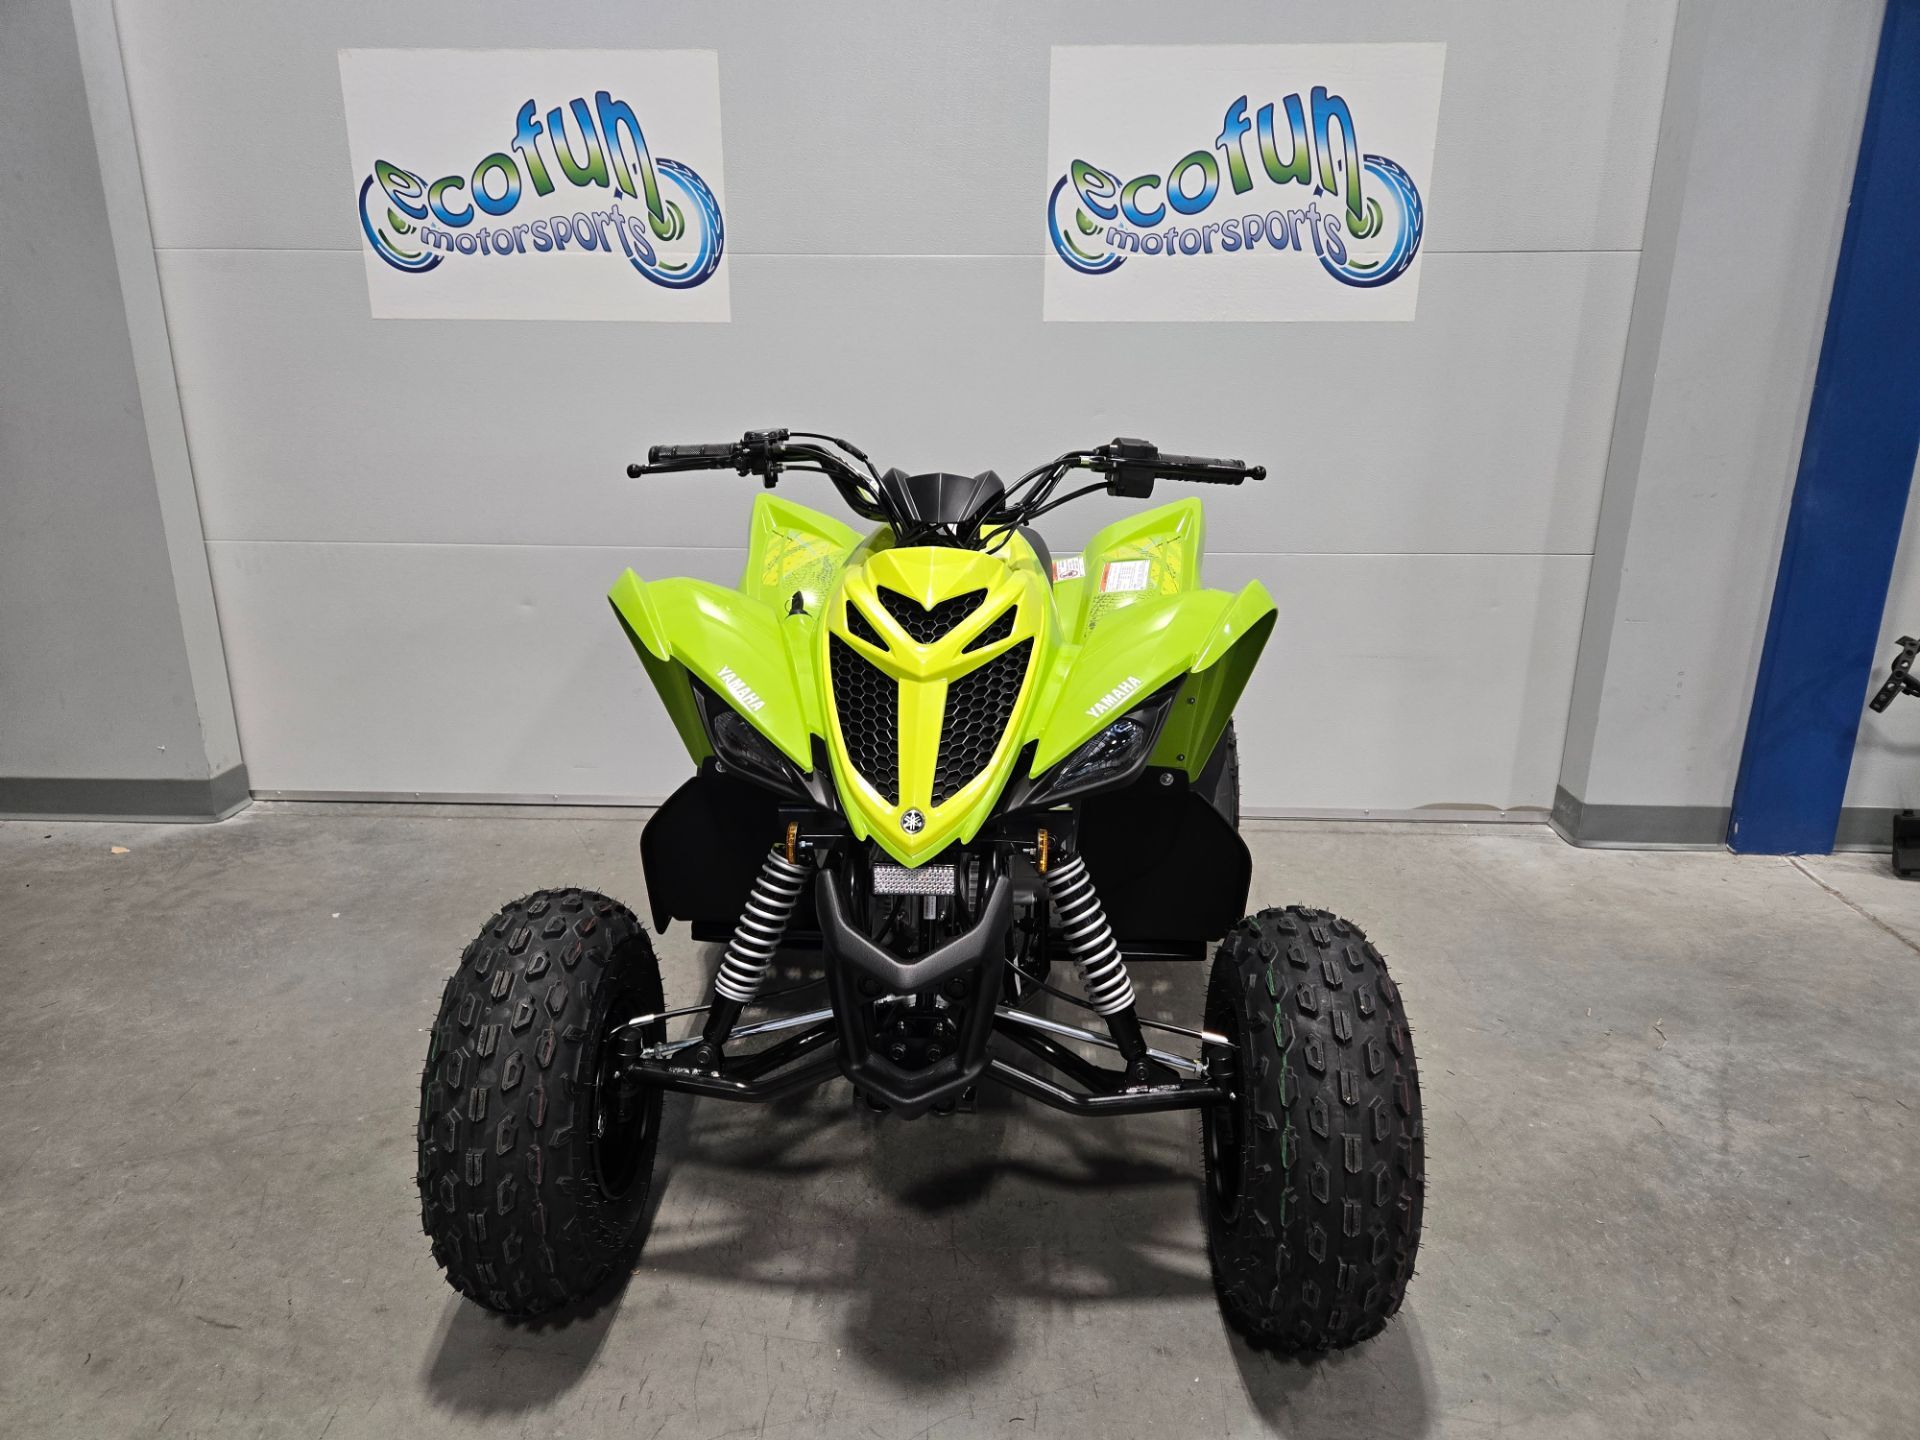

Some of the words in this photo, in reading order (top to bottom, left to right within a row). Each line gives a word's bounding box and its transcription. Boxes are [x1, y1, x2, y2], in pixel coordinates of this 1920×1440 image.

[420, 204, 656, 267] motorsports
[1105, 203, 1347, 266] motorsports
[717, 664, 766, 712] YAMAHA
[1085, 675, 1142, 718] YAMAHA
